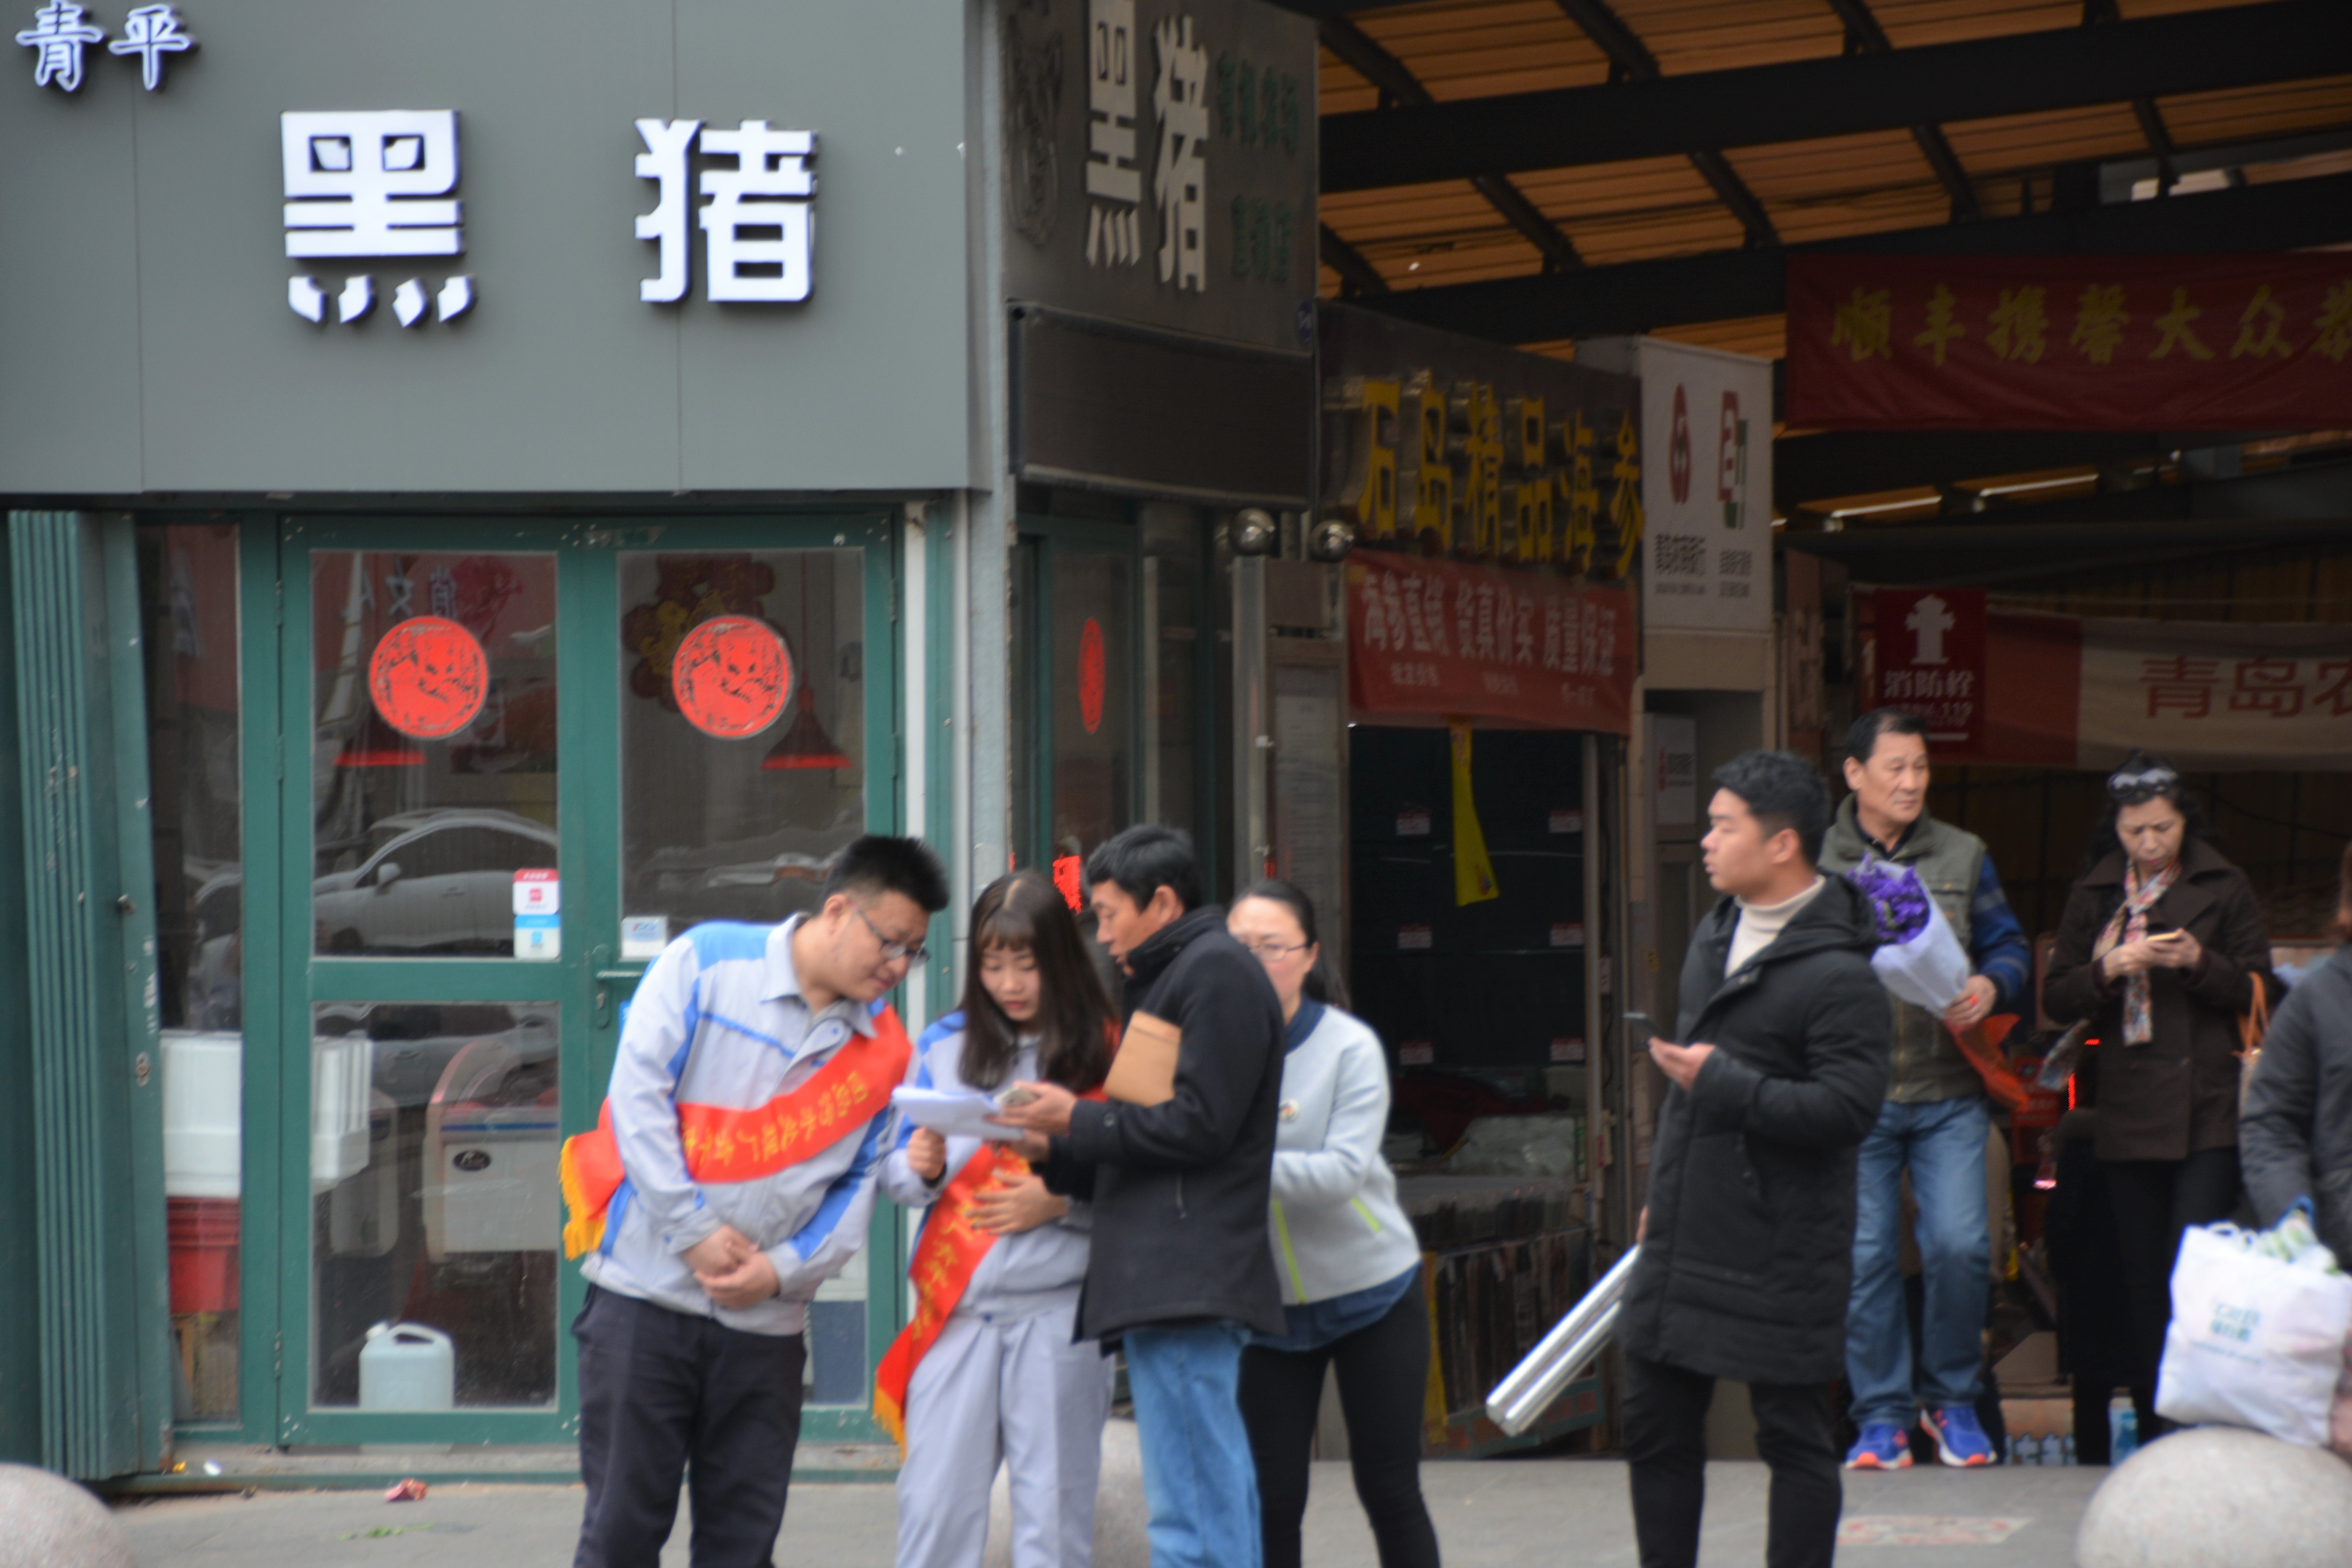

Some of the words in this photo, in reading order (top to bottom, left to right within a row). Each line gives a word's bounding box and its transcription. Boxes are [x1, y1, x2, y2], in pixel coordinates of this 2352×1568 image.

[15, 0, 193, 91] 青平
[1086, 0, 1209, 292] 黑猪
[281, 110, 815, 328] 黑猪
[1357, 367, 1644, 578] 石岛精品海参
